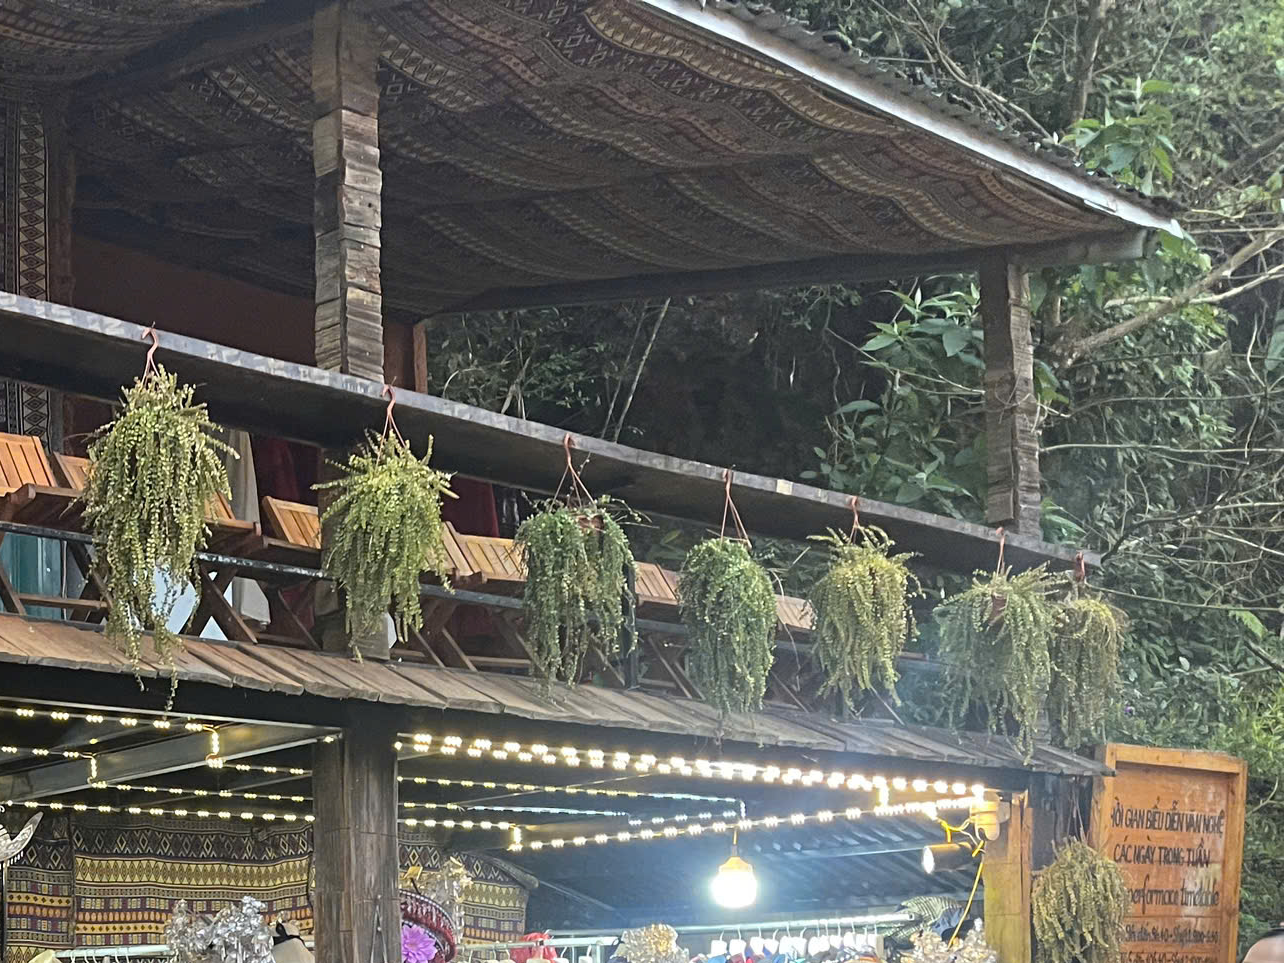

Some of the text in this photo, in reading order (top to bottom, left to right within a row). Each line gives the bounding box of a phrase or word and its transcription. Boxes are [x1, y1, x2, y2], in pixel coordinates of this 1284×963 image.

[1114, 835, 1210, 867] CÁC NGÀY TRONG TUẦN
